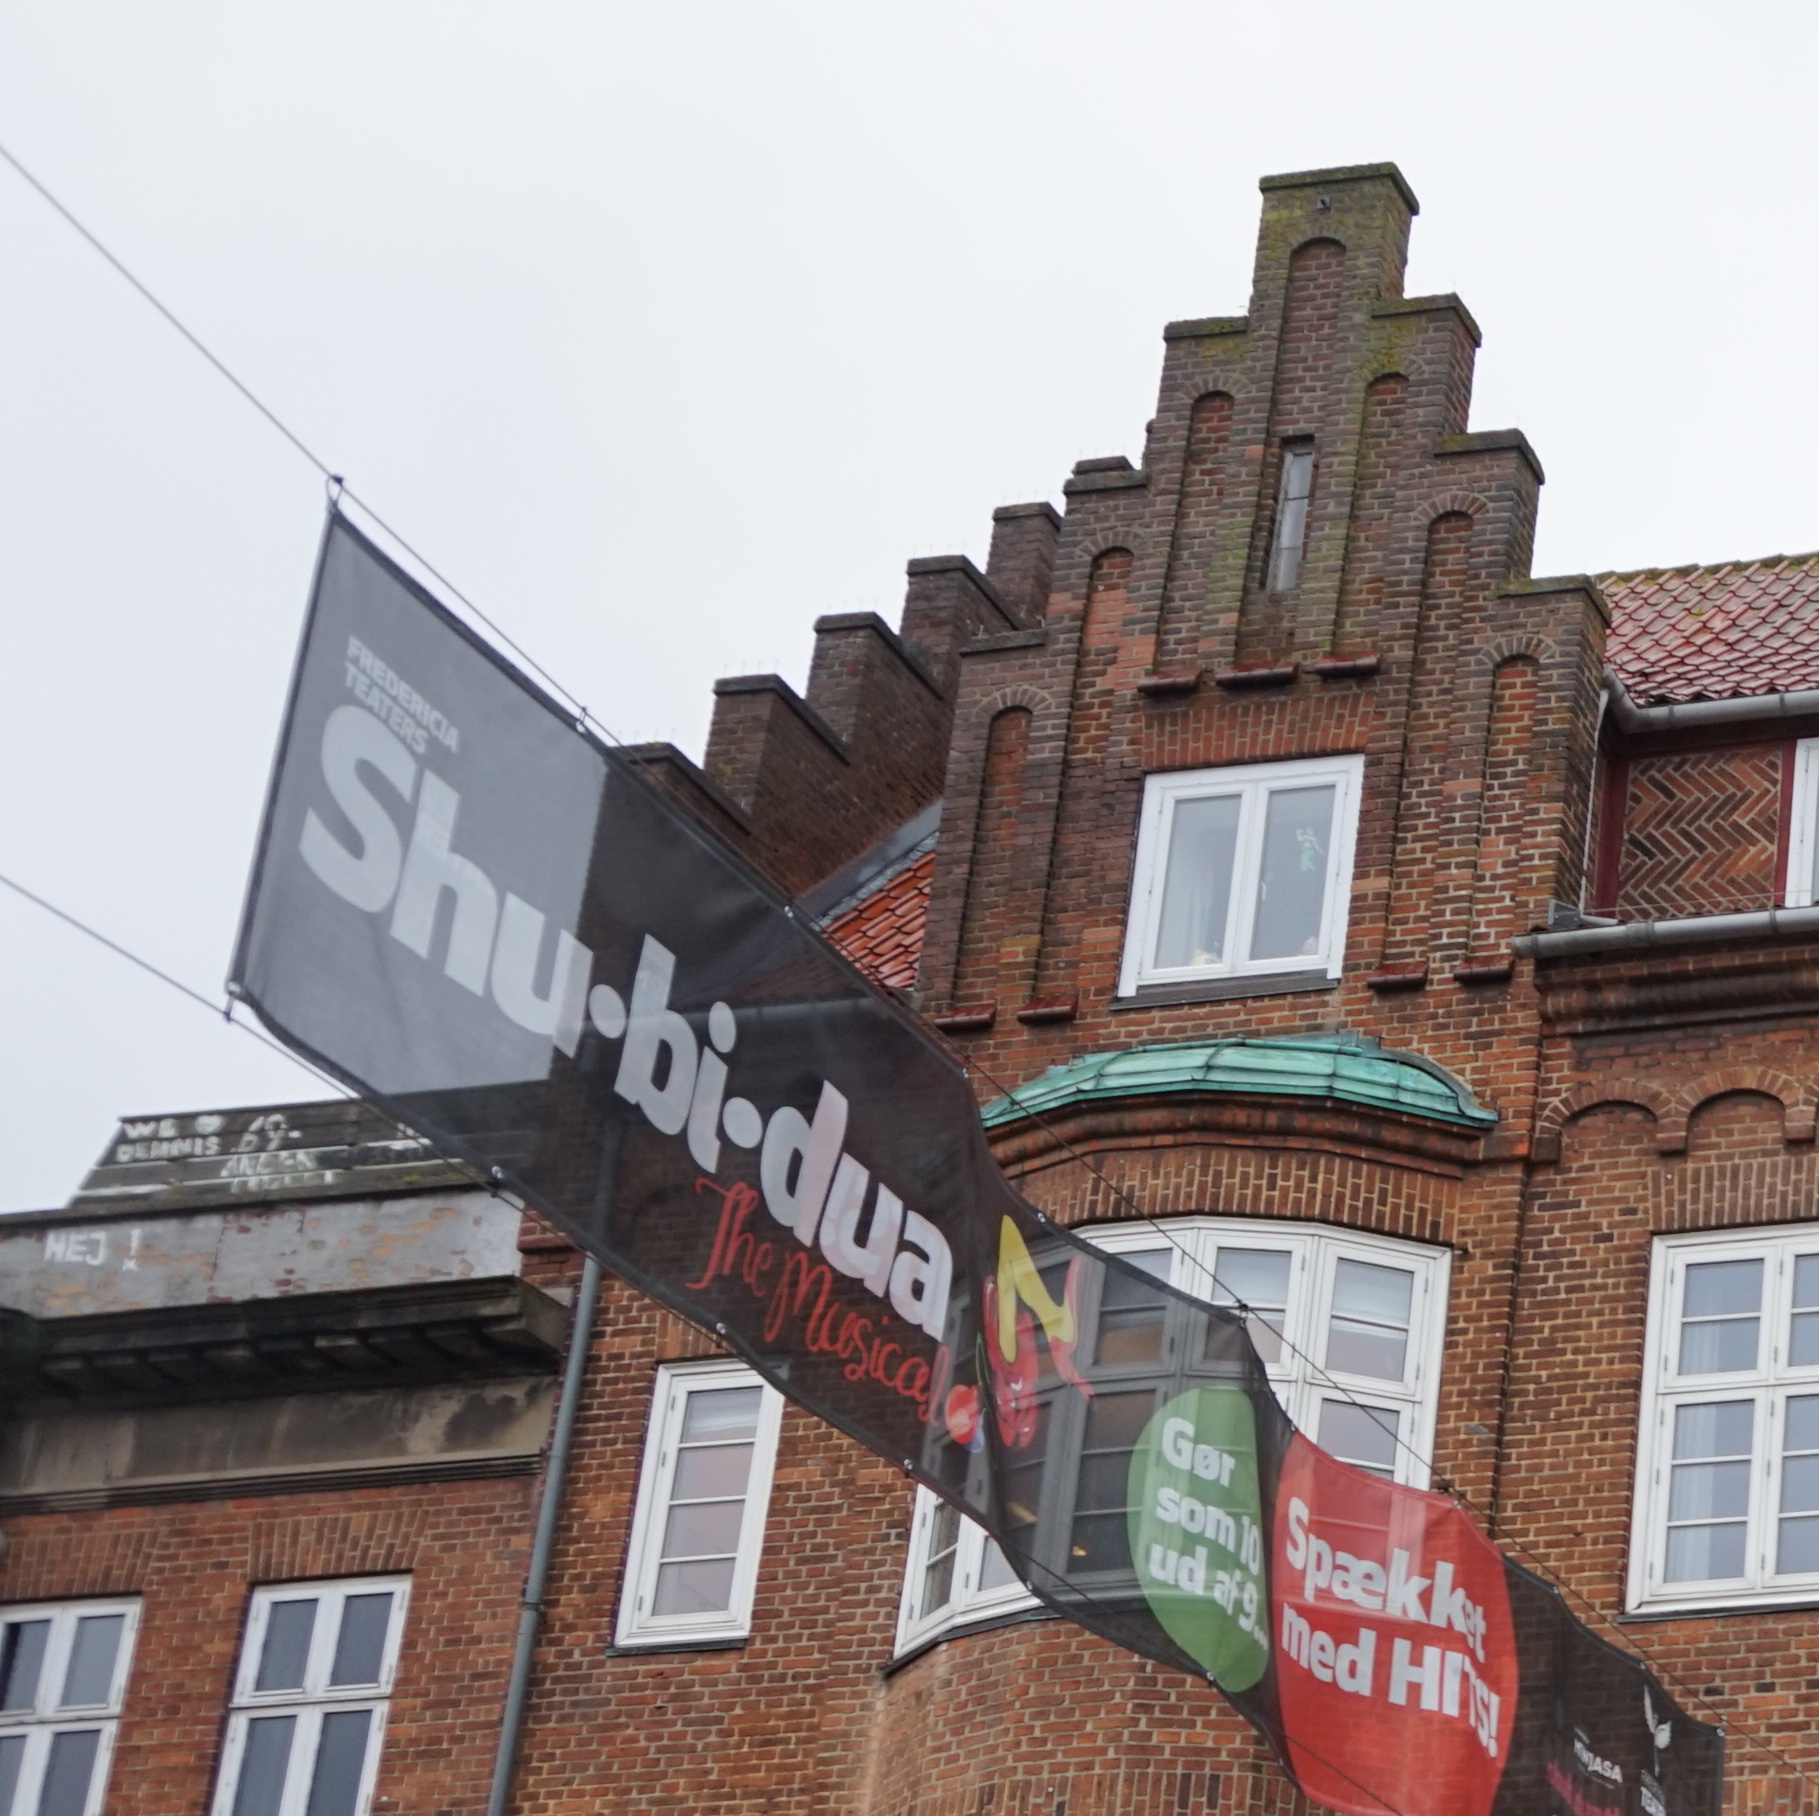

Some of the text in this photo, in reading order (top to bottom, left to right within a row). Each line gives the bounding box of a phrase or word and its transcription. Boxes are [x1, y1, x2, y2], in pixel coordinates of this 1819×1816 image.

[343, 660, 430, 755] TEATERS
[346, 633, 460, 755] FREDERICIA
[44, 1230, 108, 1267] HEJ
[685, 1177, 950, 1427] The Musical
[1160, 1416, 1237, 1488] Gør
[1155, 1485, 1261, 1577] som 10
[1148, 1542, 1209, 1597] ud
[1212, 1566, 1240, 1616] af
[1285, 1495, 1488, 1665] Spækket
[1280, 1601, 1502, 1759] med HITS!
